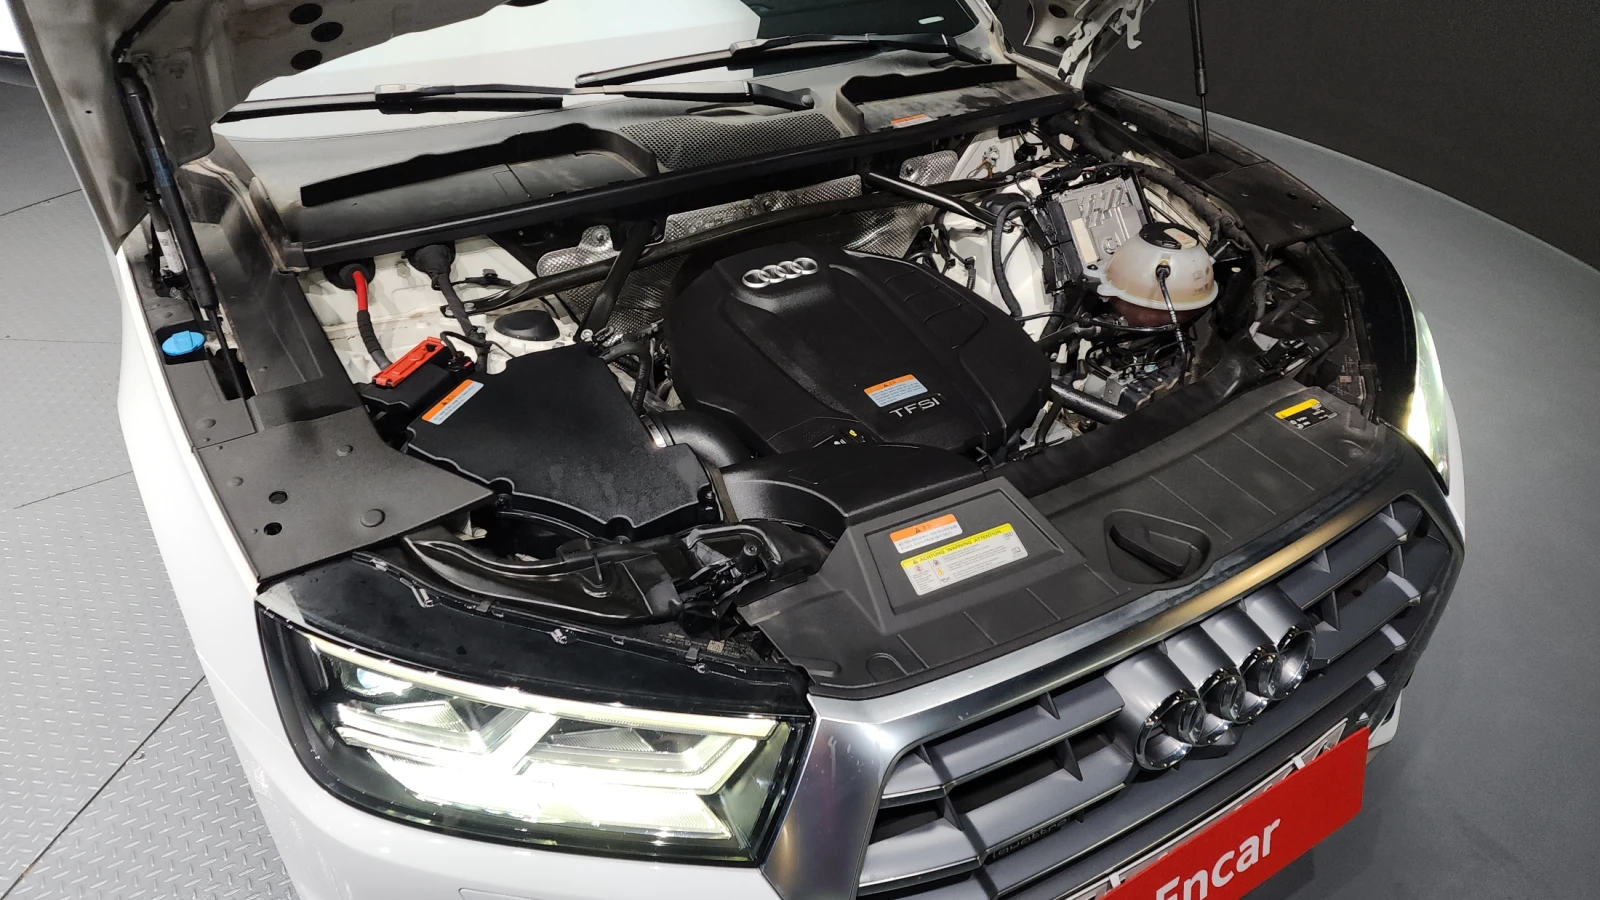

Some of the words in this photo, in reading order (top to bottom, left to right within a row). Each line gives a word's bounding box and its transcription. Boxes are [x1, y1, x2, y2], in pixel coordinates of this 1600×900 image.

[889, 397, 941, 418] TFSI
[919, 549, 945, 562] ACHTUNG
[947, 540, 972, 553] WARNING
[973, 529, 1002, 543] ATTENTION
[1156, 818, 1281, 900] Encar
